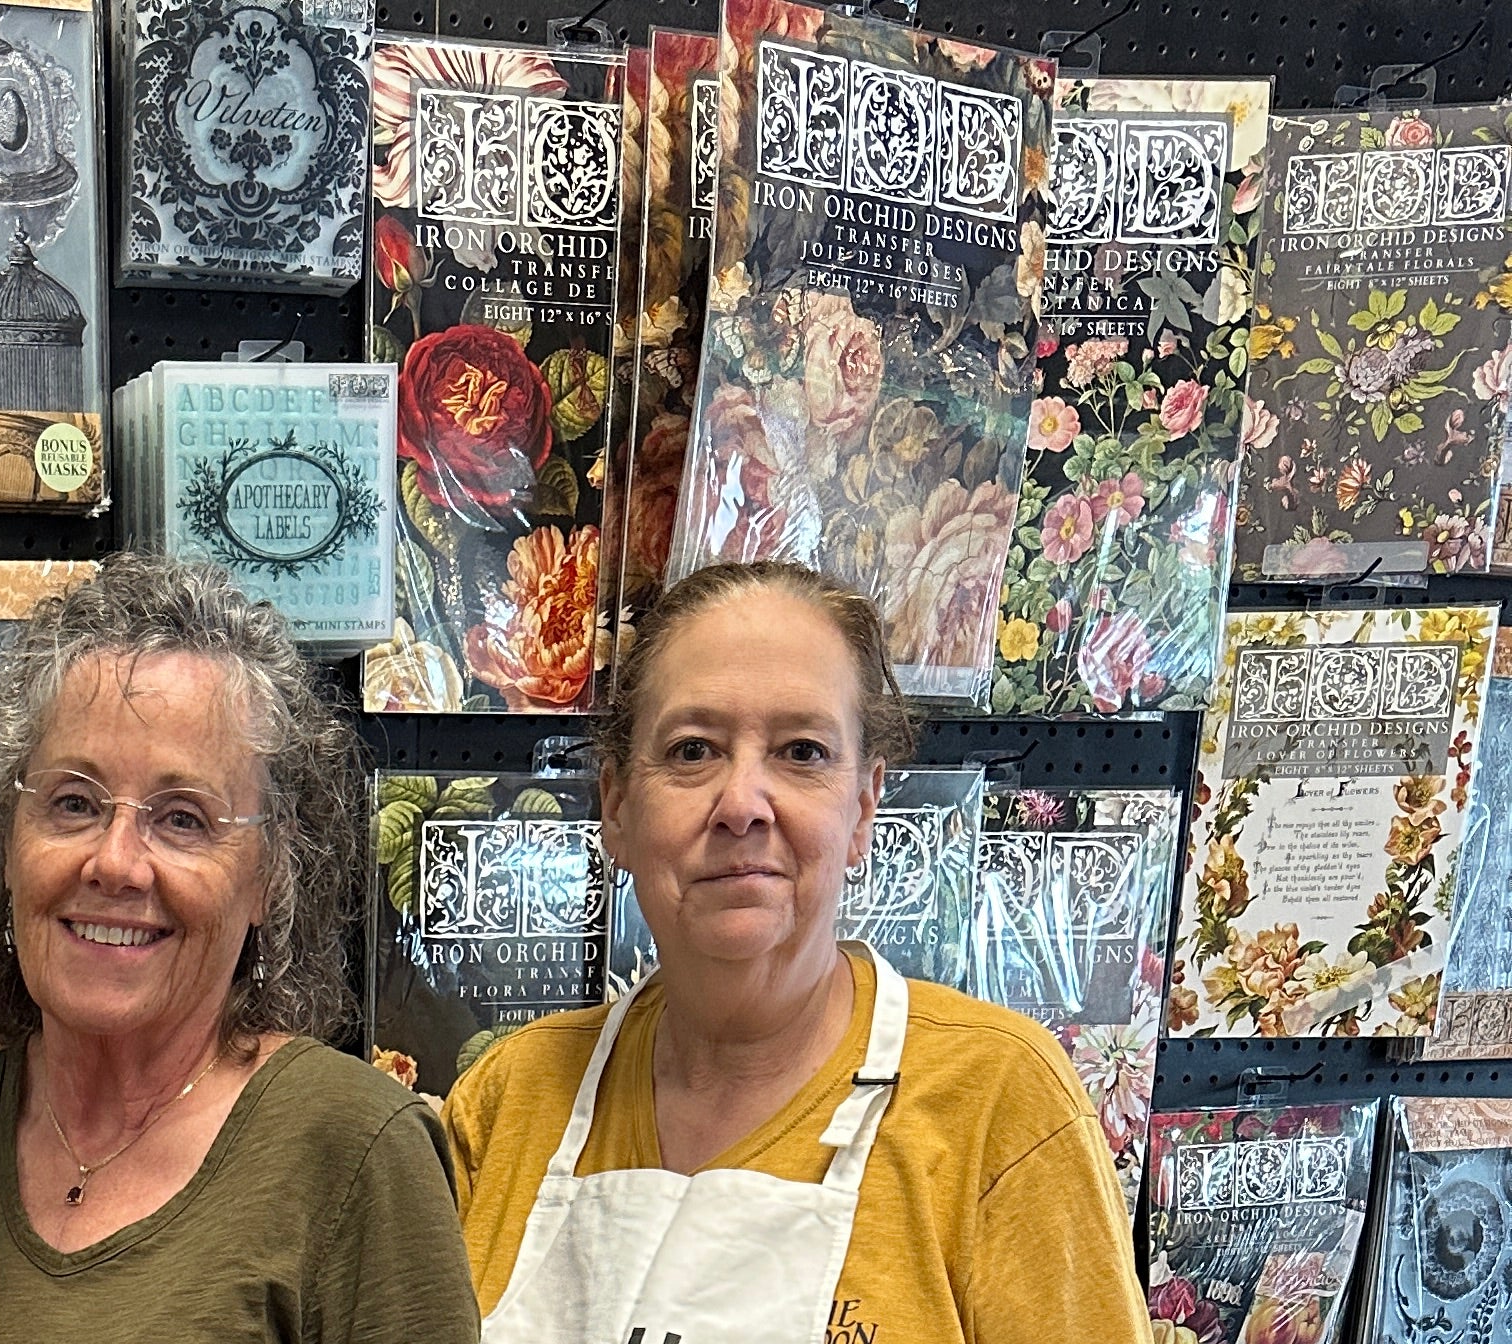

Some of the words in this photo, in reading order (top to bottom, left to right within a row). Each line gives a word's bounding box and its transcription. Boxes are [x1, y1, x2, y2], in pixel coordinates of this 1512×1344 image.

[754, 180, 814, 214] IRON
[825, 194, 916, 234] ORCHID
[925, 213, 1018, 252] DESIGNS
[415, 224, 486, 250] IRON
[497, 230, 608, 260] ORCHID
[835, 225, 936, 257] TRANSFER
[1281, 234, 1329, 253] IRON
[1338, 231, 1416, 251] ORCHID
[1424, 226, 1506, 246] DESIGNS
[800, 240, 846, 262] JOIE
[858, 250, 893, 270] DES
[905, 257, 963, 283] ROSES
[1105, 248, 1221, 273] DESIGNS
[1305, 260, 1397, 276] FAIRYTALE
[1405, 256, 1476, 271] FLORALS
[445, 275, 554, 299] COLLAGE
[808, 269, 851, 291] EIGHT
[910, 286, 959, 309] SHEETS
[1327, 277, 1361, 291] EIGHT
[1409, 273, 1450, 287] SHEETS
[484, 305, 534, 323] EIGHT
[1088, 321, 1145, 337] SHEETS
[41, 438, 87, 453] BONUS
[42, 453, 87, 462] REUSABLE
[41, 462, 88, 477] MASKS
[233, 484, 332, 511] APOTHECARY
[255, 514, 312, 542] LABELS
[314, 619, 341, 631] MINI
[343, 619, 387, 631] STAMPS
[1231, 724, 1281, 740] IRON
[1286, 723, 1362, 738] ORCHID
[1369, 721, 1450, 736] DESIGNS
[1257, 749, 1307, 761] LOVER
[1343, 747, 1418, 760] FLOWERS
[1298, 738, 1379, 750] TRANSFER
[1276, 764, 1309, 775] EIGHT
[1354, 763, 1395, 774] SHEETS
[496, 942, 599, 964] ORCHID
[459, 984, 528, 998] FLORA
[1177, 1211, 1213, 1225] IRON
[1220, 1207, 1278, 1222] ORCHID
[1285, 1204, 1347, 1218] DESIGNS
